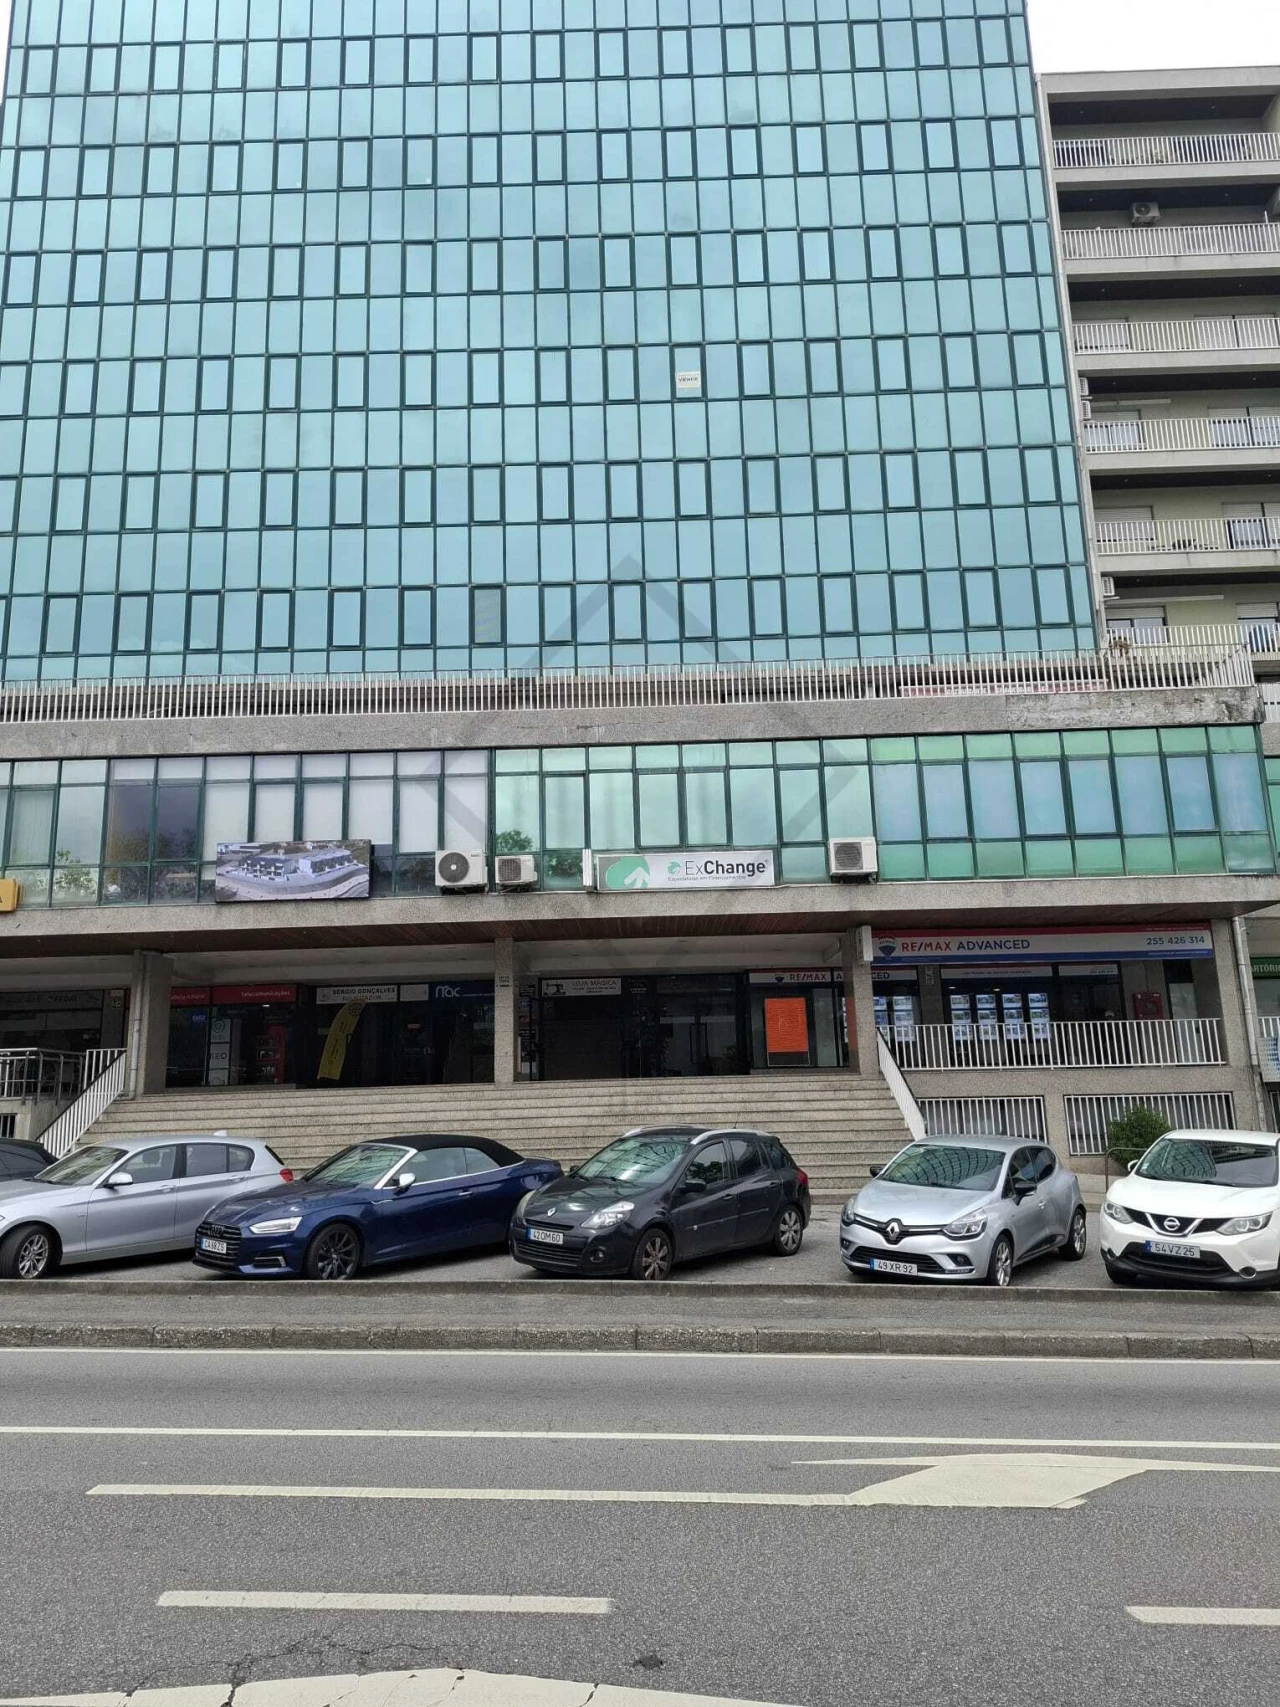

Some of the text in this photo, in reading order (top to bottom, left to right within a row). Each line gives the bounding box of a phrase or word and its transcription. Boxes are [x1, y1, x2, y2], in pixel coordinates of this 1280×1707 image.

[685, 860, 766, 877] ExChange
[1146, 937, 1165, 945] 255
[1189, 936, 1205, 944] 314
[901, 939, 1031, 952] RE/MAX ADVANCED
[789, 973, 827, 982] RE/MAX
[357, 987, 396, 996] GONÇALVES
